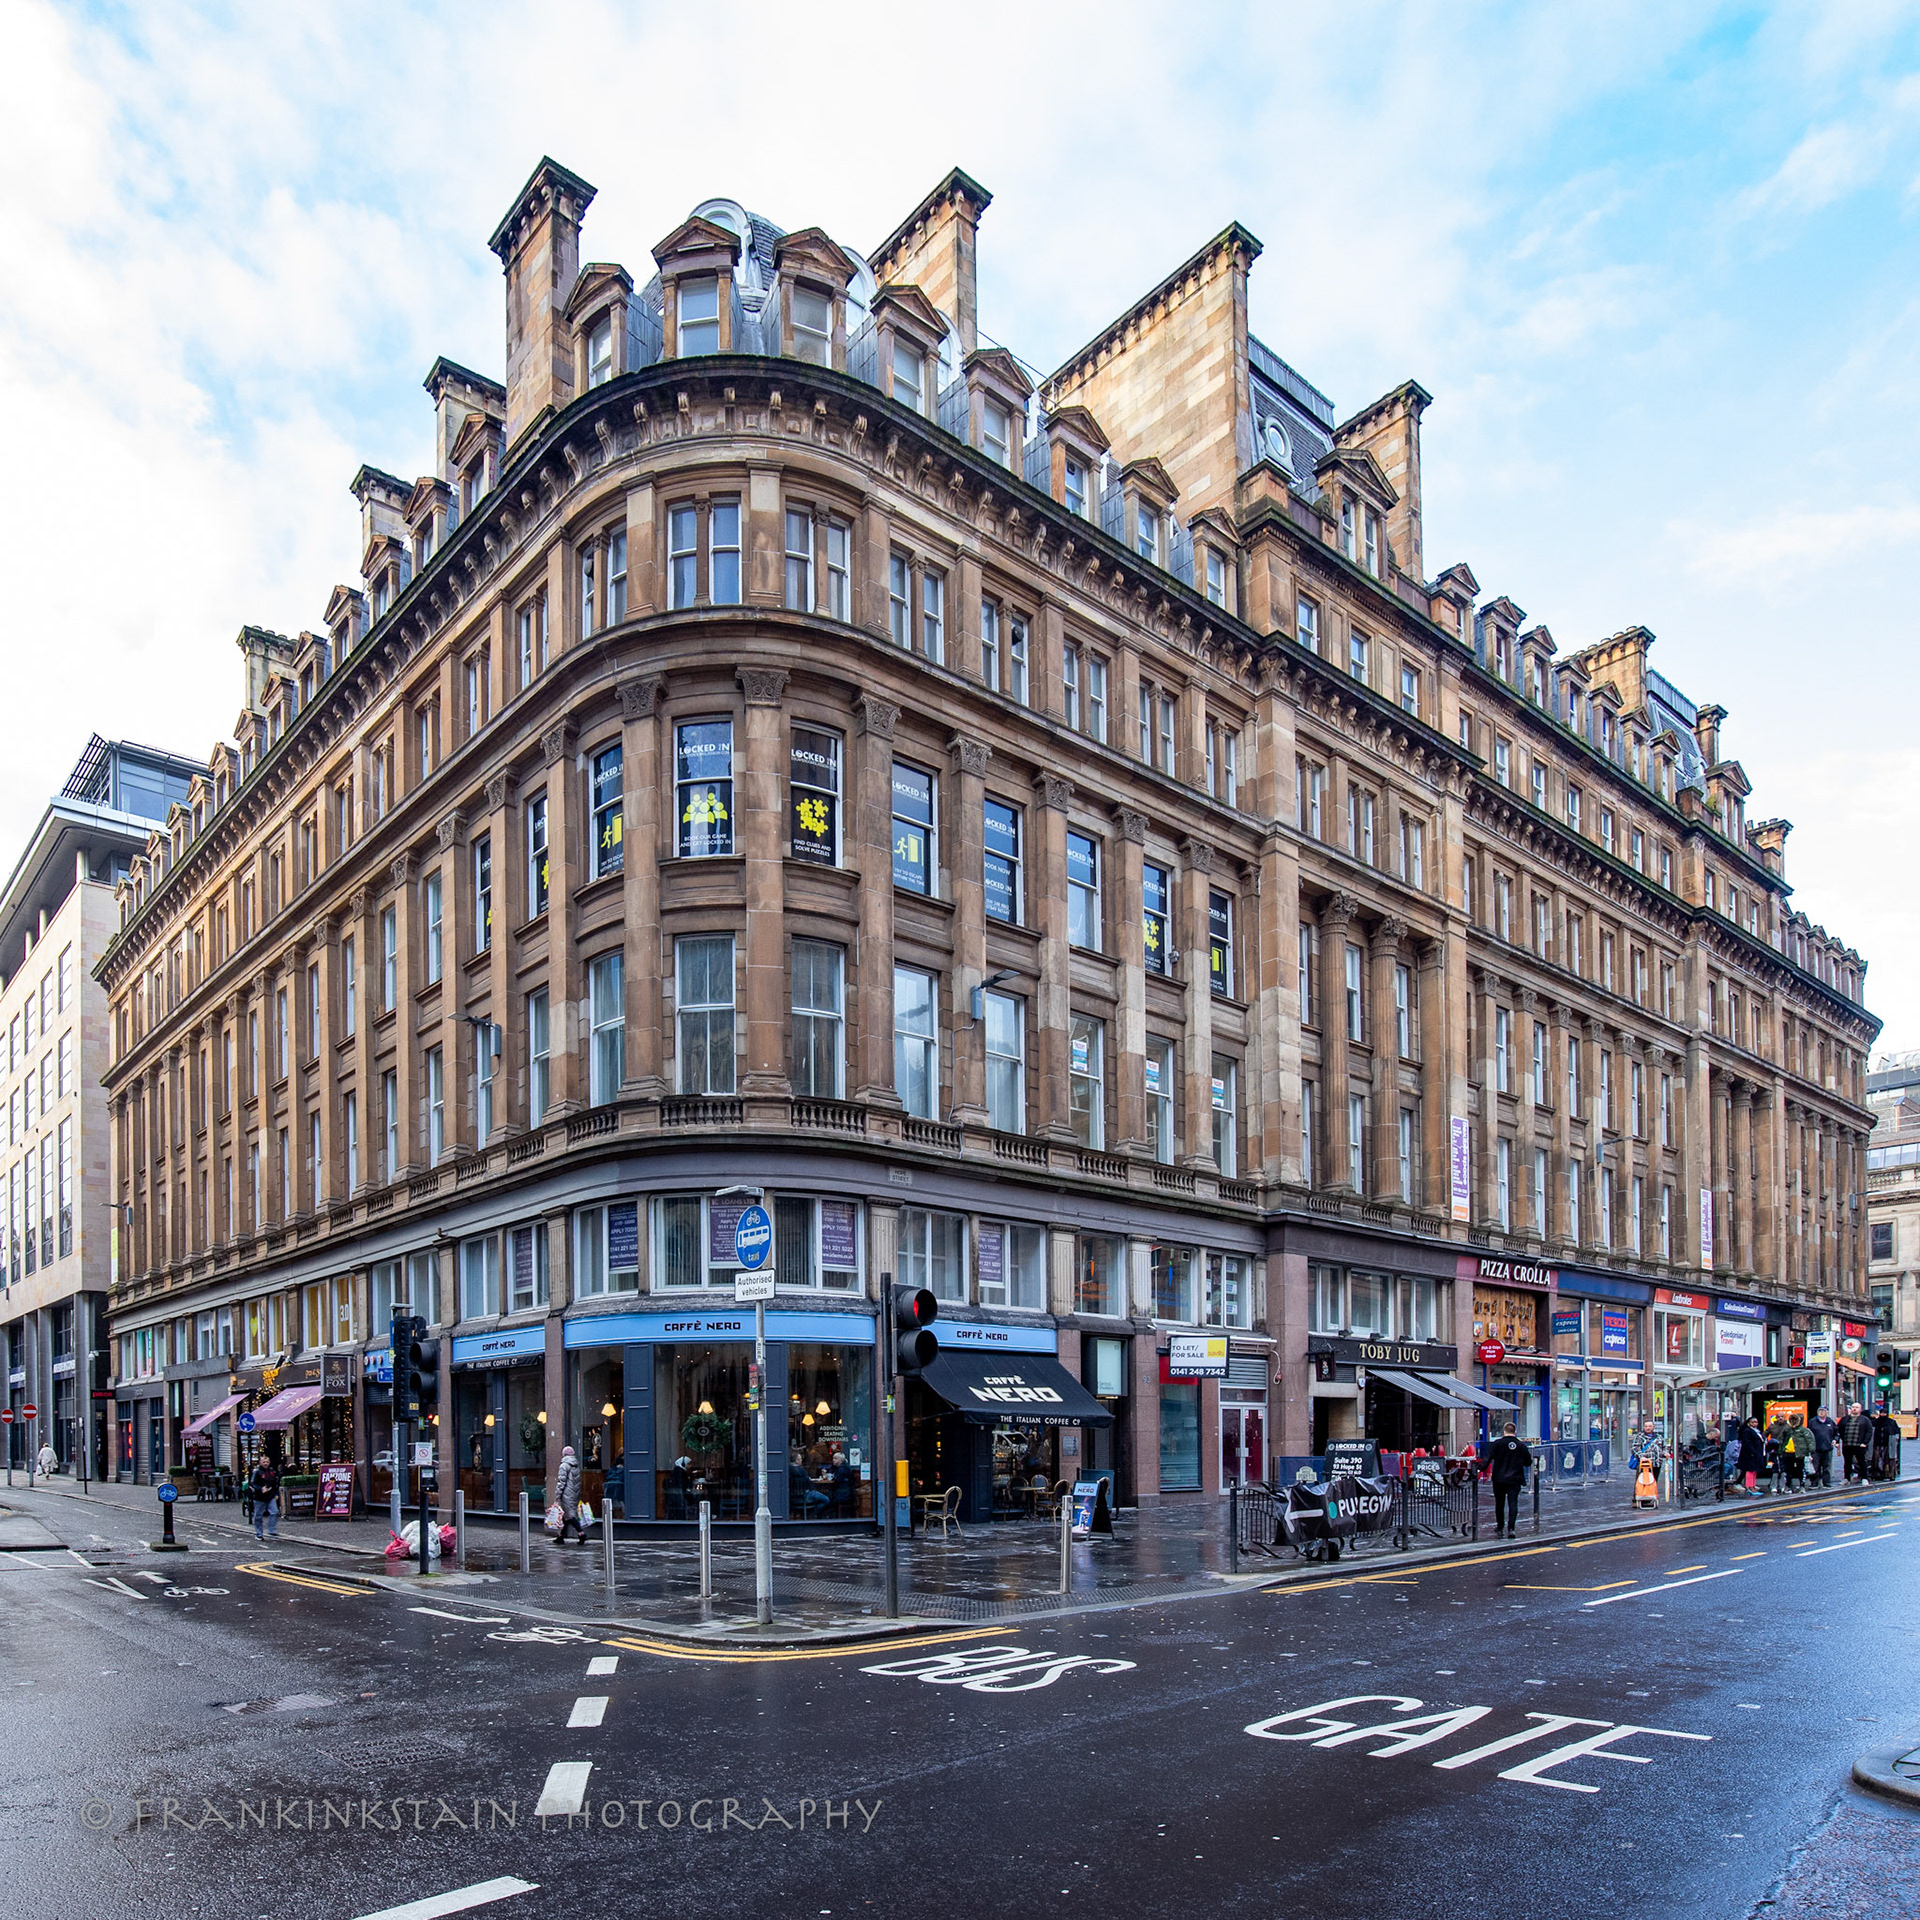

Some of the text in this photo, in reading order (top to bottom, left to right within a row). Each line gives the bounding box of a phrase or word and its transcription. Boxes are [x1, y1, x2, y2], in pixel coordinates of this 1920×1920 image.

[679, 743, 715, 755] LOCKED
[791, 749, 825, 764] LOCKED
[594, 765, 618, 785] LOCKED
[892, 780, 919, 797] LOCKED
[793, 838, 805, 846] FIND
[1480, 1259, 1551, 1285] PIZZA CROLLA
[737, 1274, 772, 1287] Authorised
[742, 1287, 768, 1297] vehicles
[1555, 1312, 1580, 1320] TESCO
[664, 1320, 741, 1332] CAFFÈ NERO
[1555, 1320, 1578, 1328] express
[1604, 1316, 1627, 1329] TESCO
[956, 1329, 1008, 1341] CAFFÈ NERO
[1720, 1329, 1744, 1340] Caledonian
[482, 1340, 516, 1352] CAFFÈ NERO
[1604, 1333, 1626, 1348] express
[1720, 1337, 1734, 1346] Travel
[1182, 1344, 1200, 1352] LET/
[1359, 1343, 1420, 1363] TOBY JUG
[466, 1359, 510, 1370] THE ITALIAN COFFEE
[1170, 1367, 1226, 1376] 0141 248 7342
[325, 1378, 346, 1388] FOX
[983, 1374, 1026, 1385] CAFFÈ
[1142, 1374, 1151, 1384] 93
[968, 1386, 1064, 1403] NERO
[1000, 1414, 1069, 1425] THE ITALIAN COFFEE
[1333, 1456, 1363, 1464] Suite 390
[1340, 1463, 1355, 1471] Hope
[1355, 1463, 1363, 1471] St
[858, 1645, 1138, 1693] BUS
[1244, 1695, 1713, 1793] GATE
